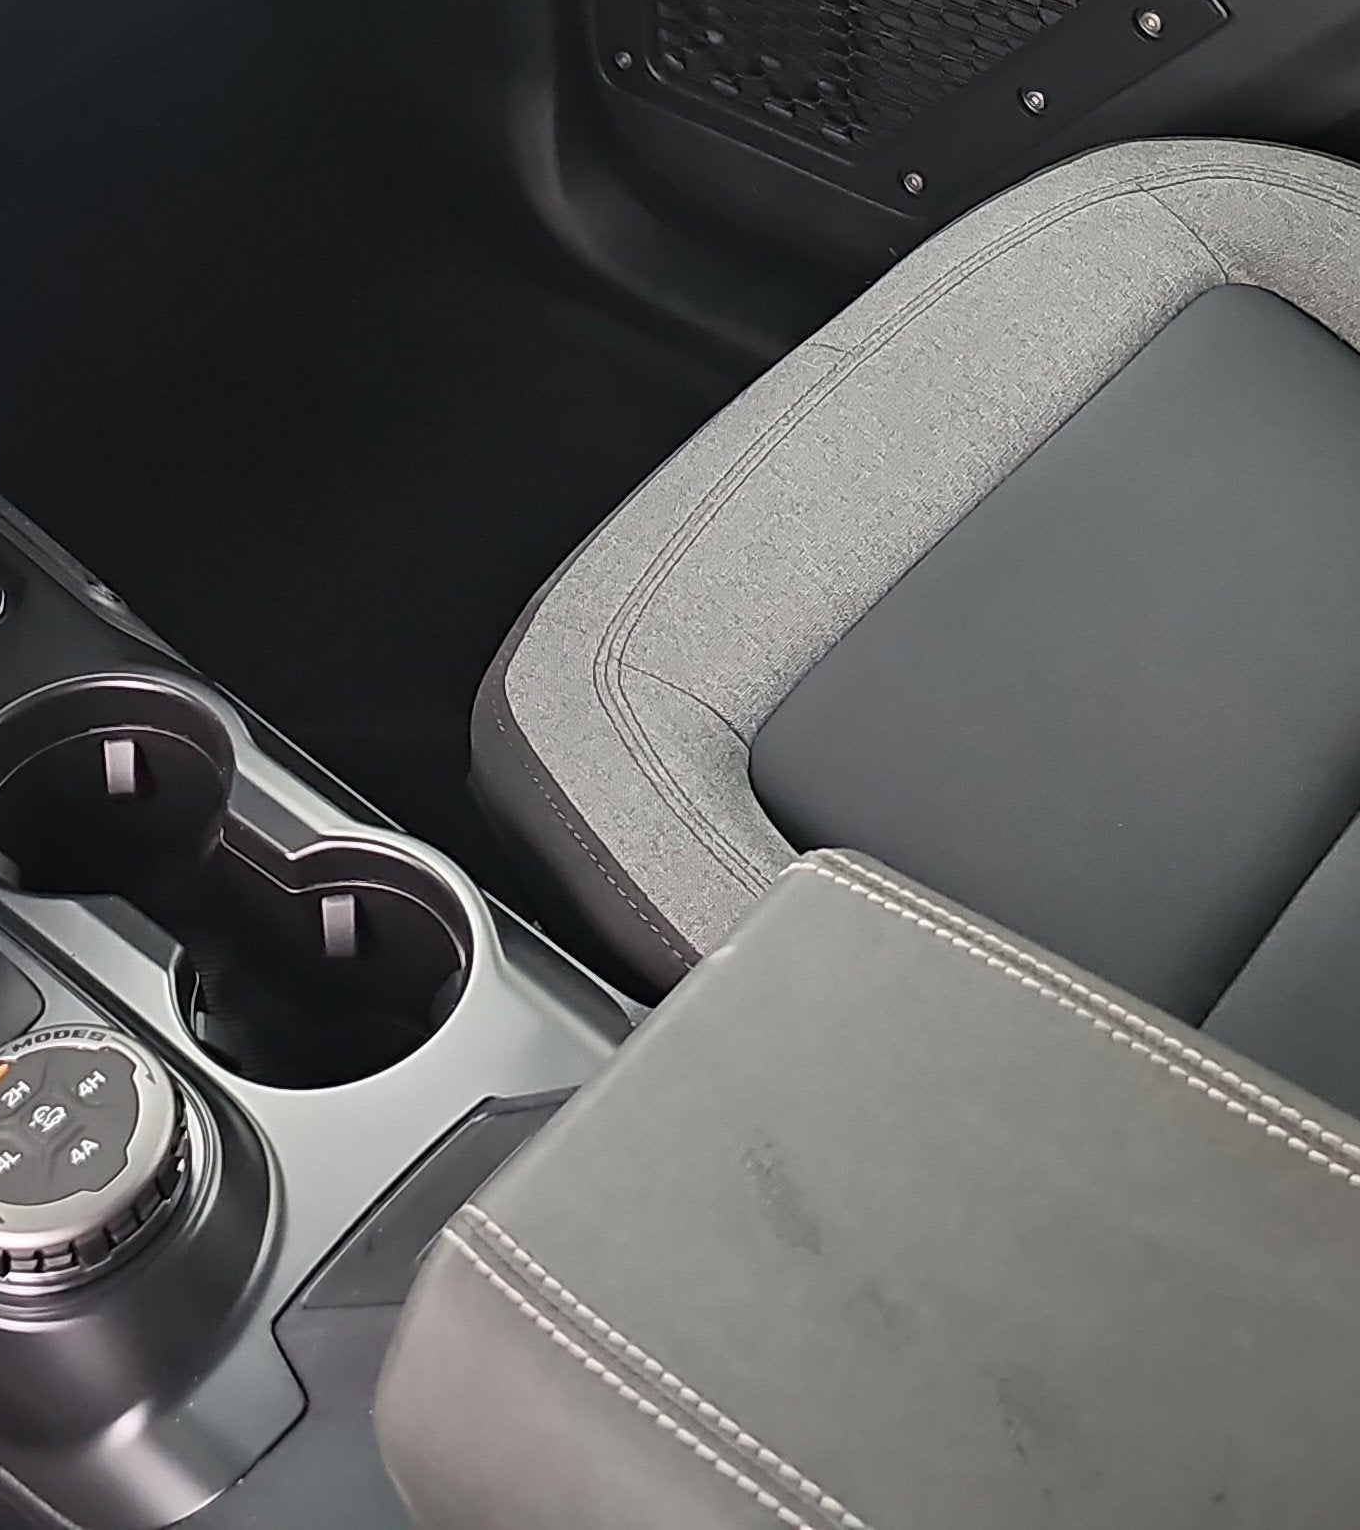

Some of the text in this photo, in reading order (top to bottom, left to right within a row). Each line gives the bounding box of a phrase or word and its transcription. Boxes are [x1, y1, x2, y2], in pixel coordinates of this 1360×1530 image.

[11, 1028, 108, 1053] MODES
[0, 1080, 32, 1109] 2H
[77, 1070, 107, 1098] 4H
[69, 1138, 100, 1166] 4A
